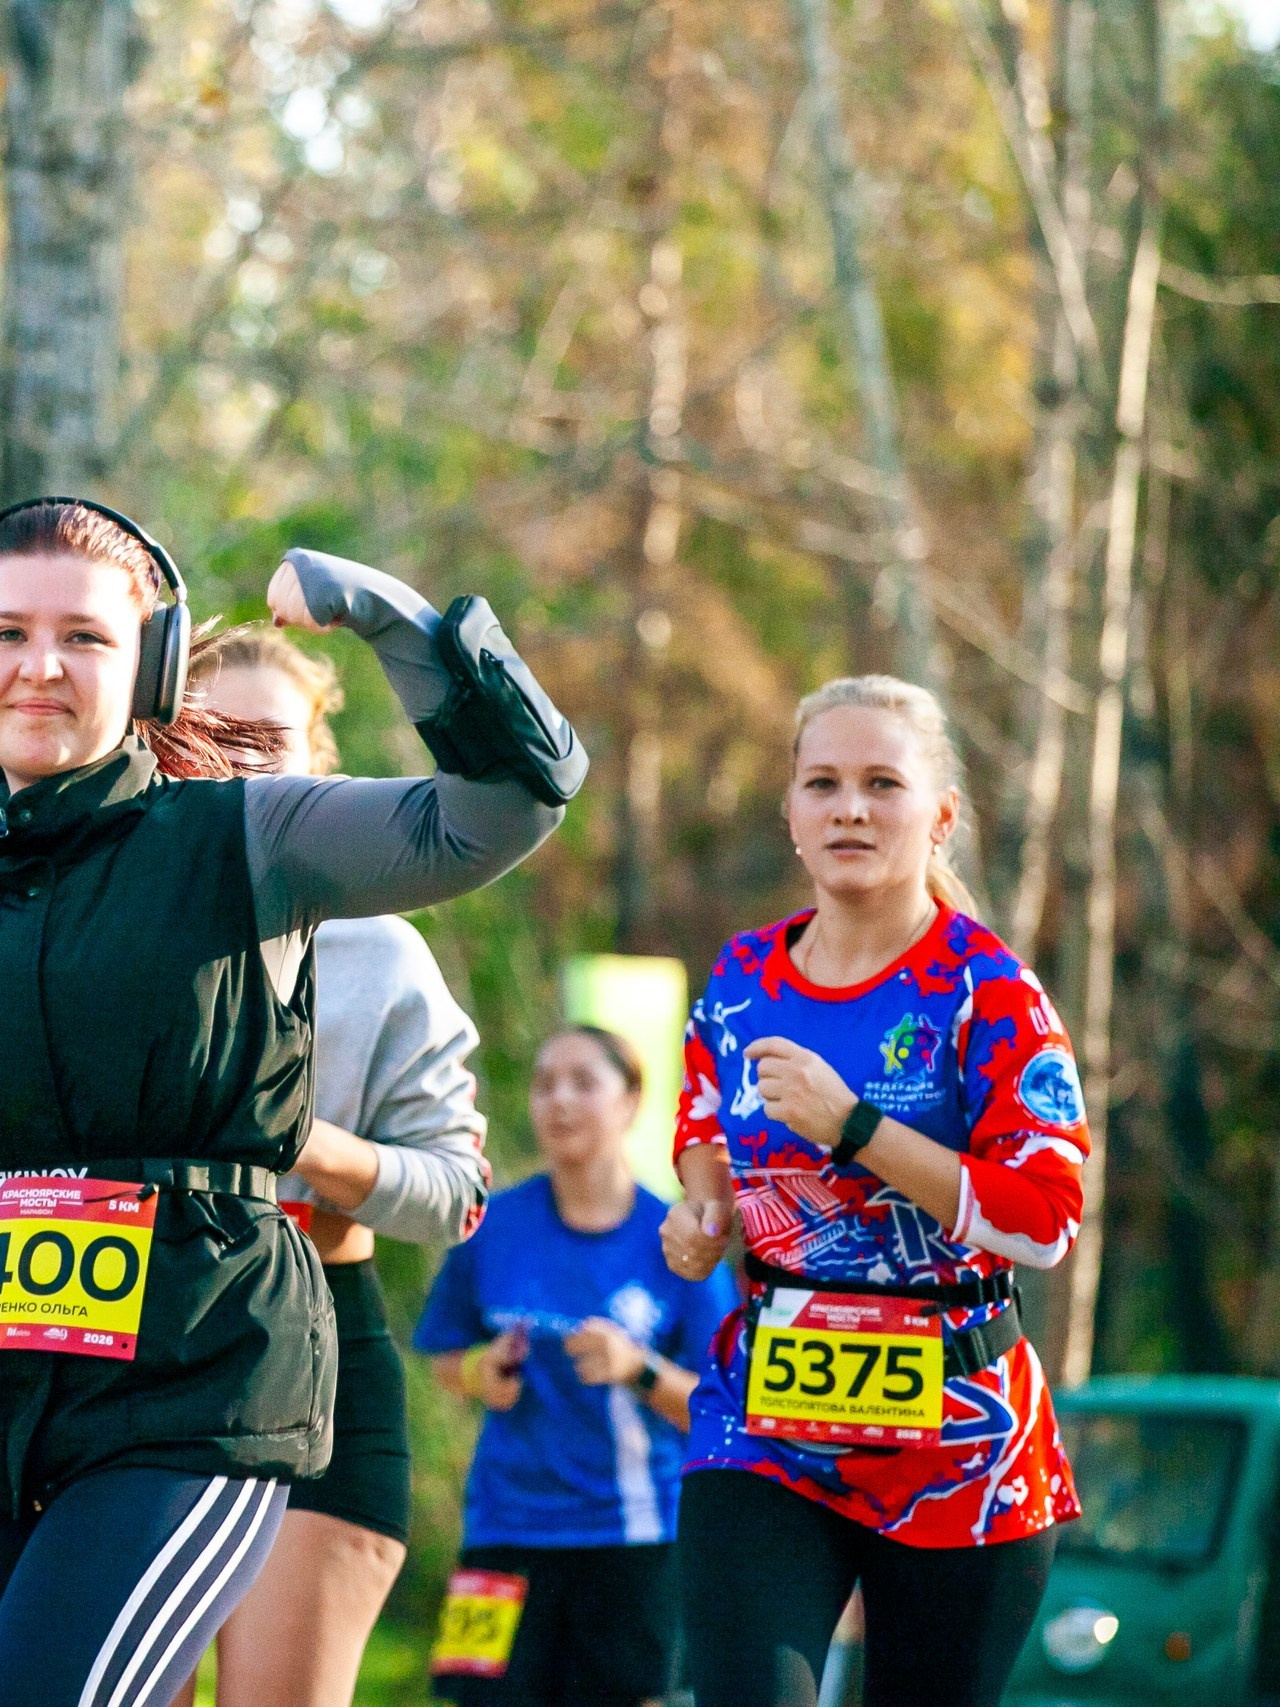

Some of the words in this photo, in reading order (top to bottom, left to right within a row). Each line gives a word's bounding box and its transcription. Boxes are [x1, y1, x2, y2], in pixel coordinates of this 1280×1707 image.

[2, 1188, 82, 1200] КРАСНОЯРСКИЕ
[19, 1198, 57, 1208] МОСТЫ
[108, 1200, 117, 1210] 5
[119, 1201, 140, 1213] КМ
[40, 1303, 89, 1318] ОЛЬГА
[83, 1332, 114, 1346] 2026
[764, 1337, 924, 1401] 5375
[849, 1405, 925, 1418] ВАЛЕНТИНА
